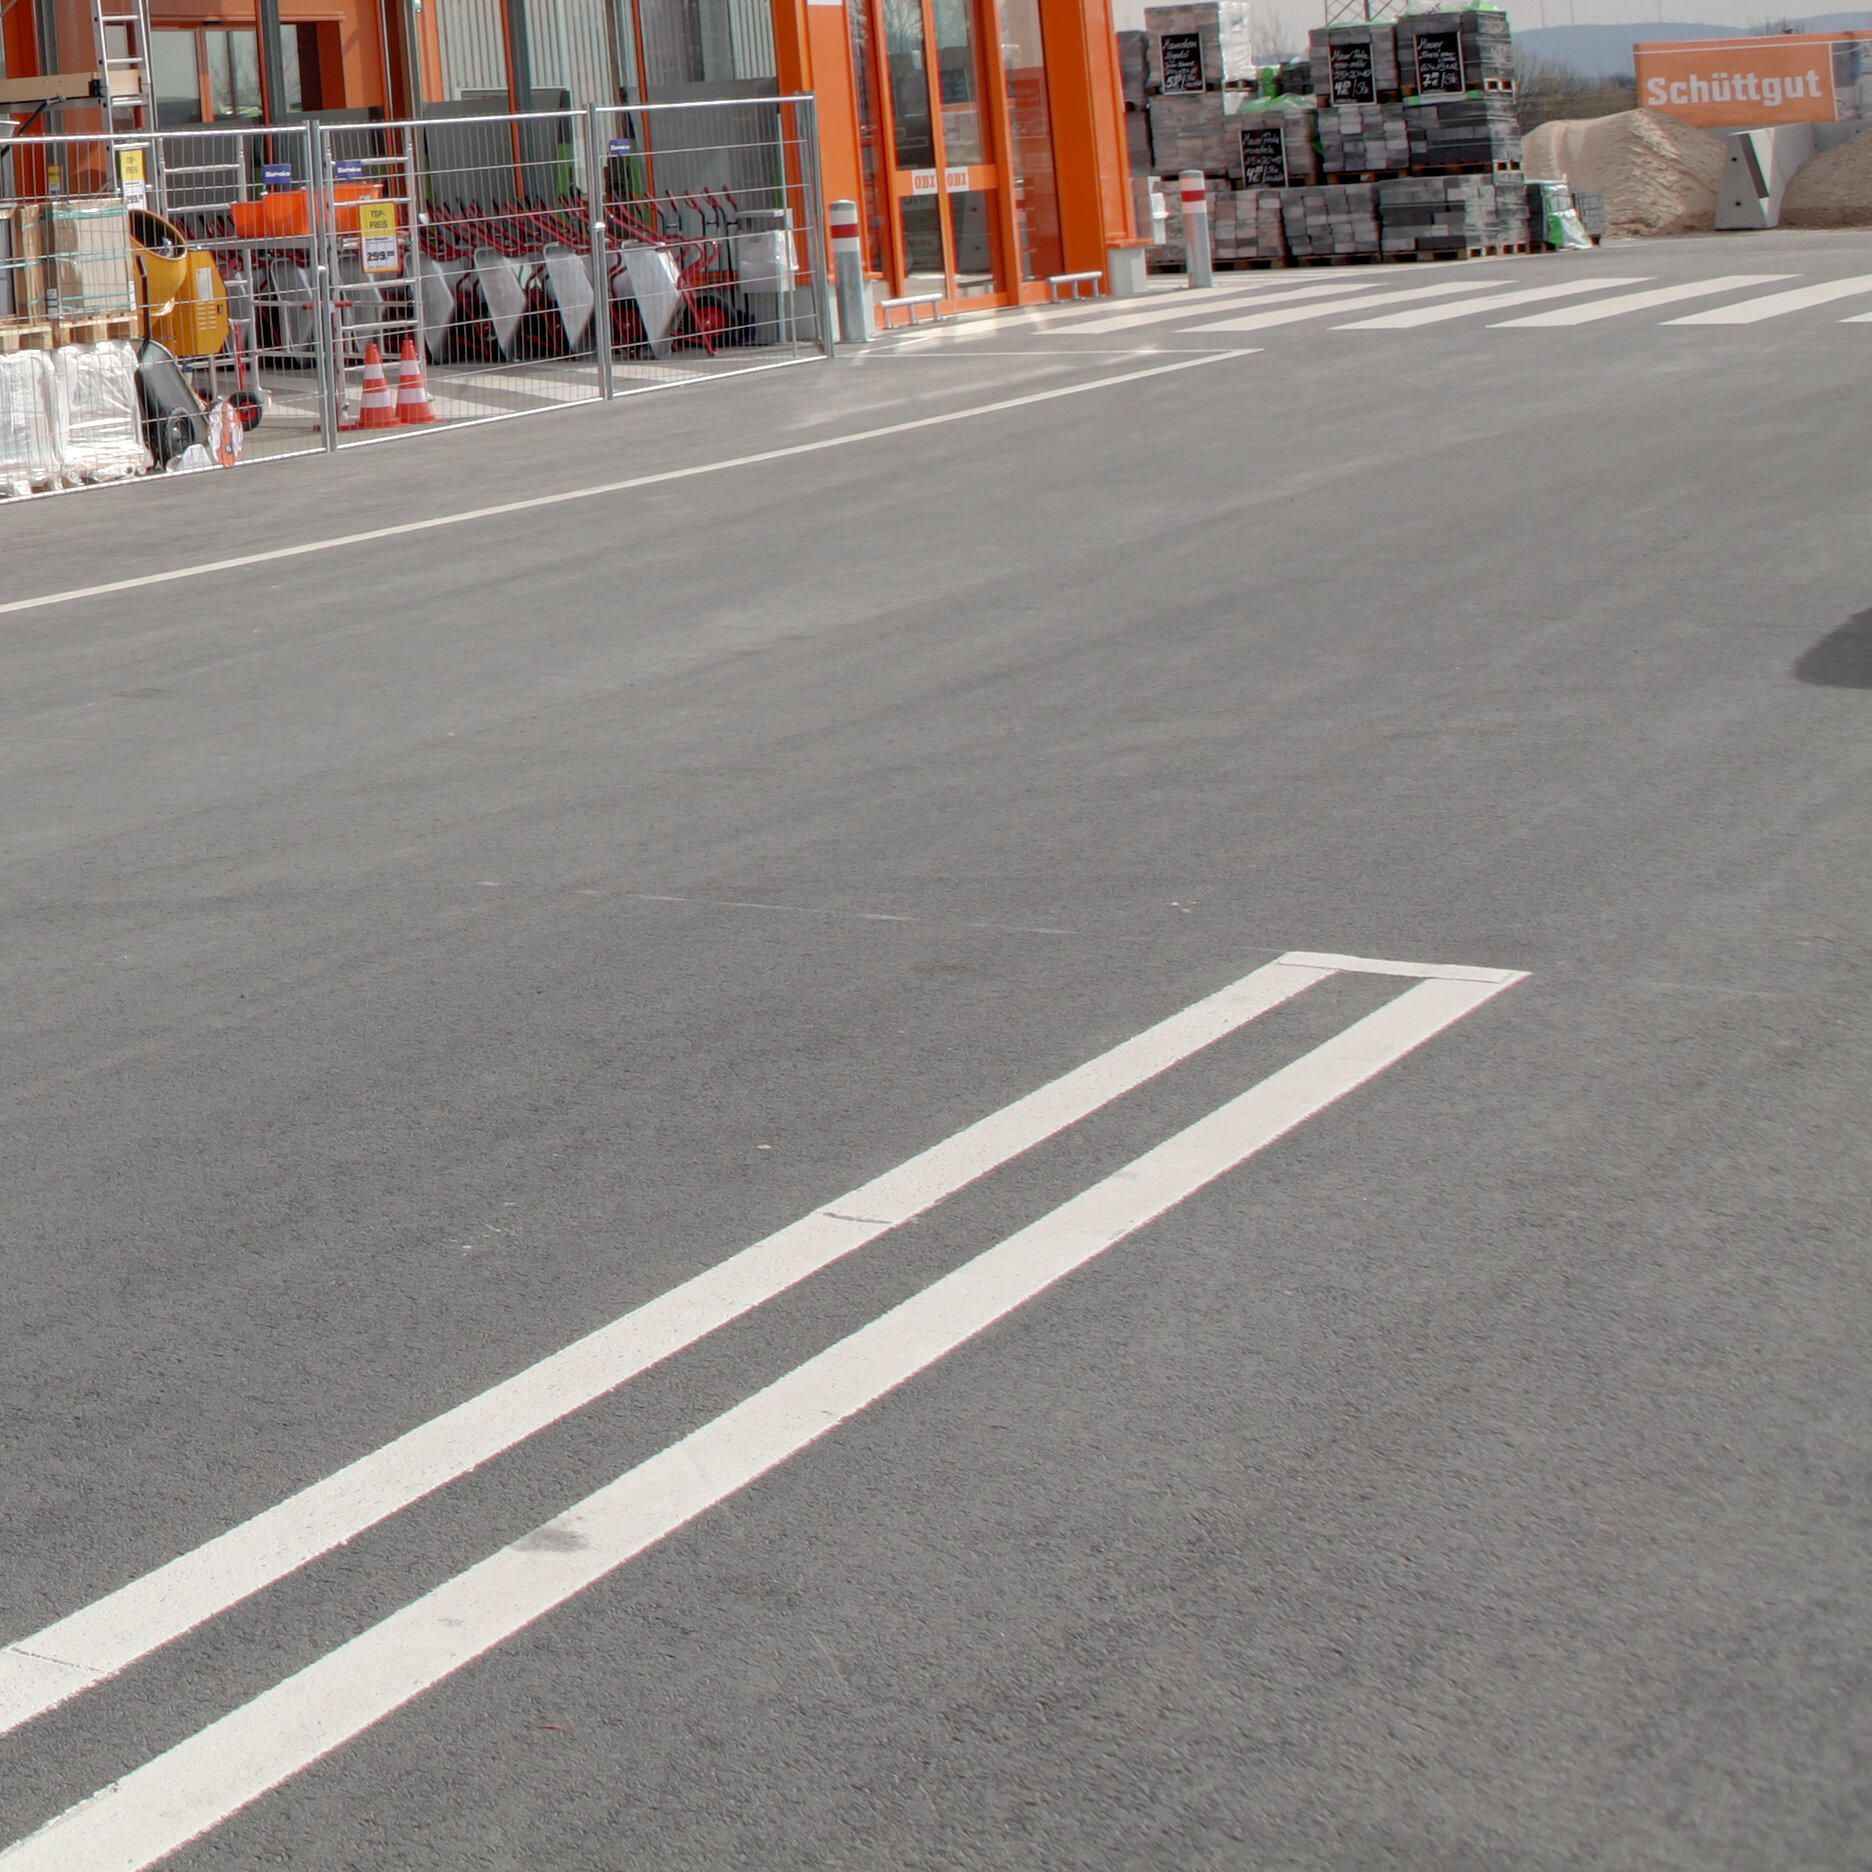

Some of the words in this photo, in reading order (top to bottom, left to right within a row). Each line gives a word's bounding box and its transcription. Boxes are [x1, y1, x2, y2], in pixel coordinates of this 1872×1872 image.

[1647, 69, 1822, 106] Schüttgut
[914, 174, 936, 190] OBI
[946, 173, 967, 187] OBI
